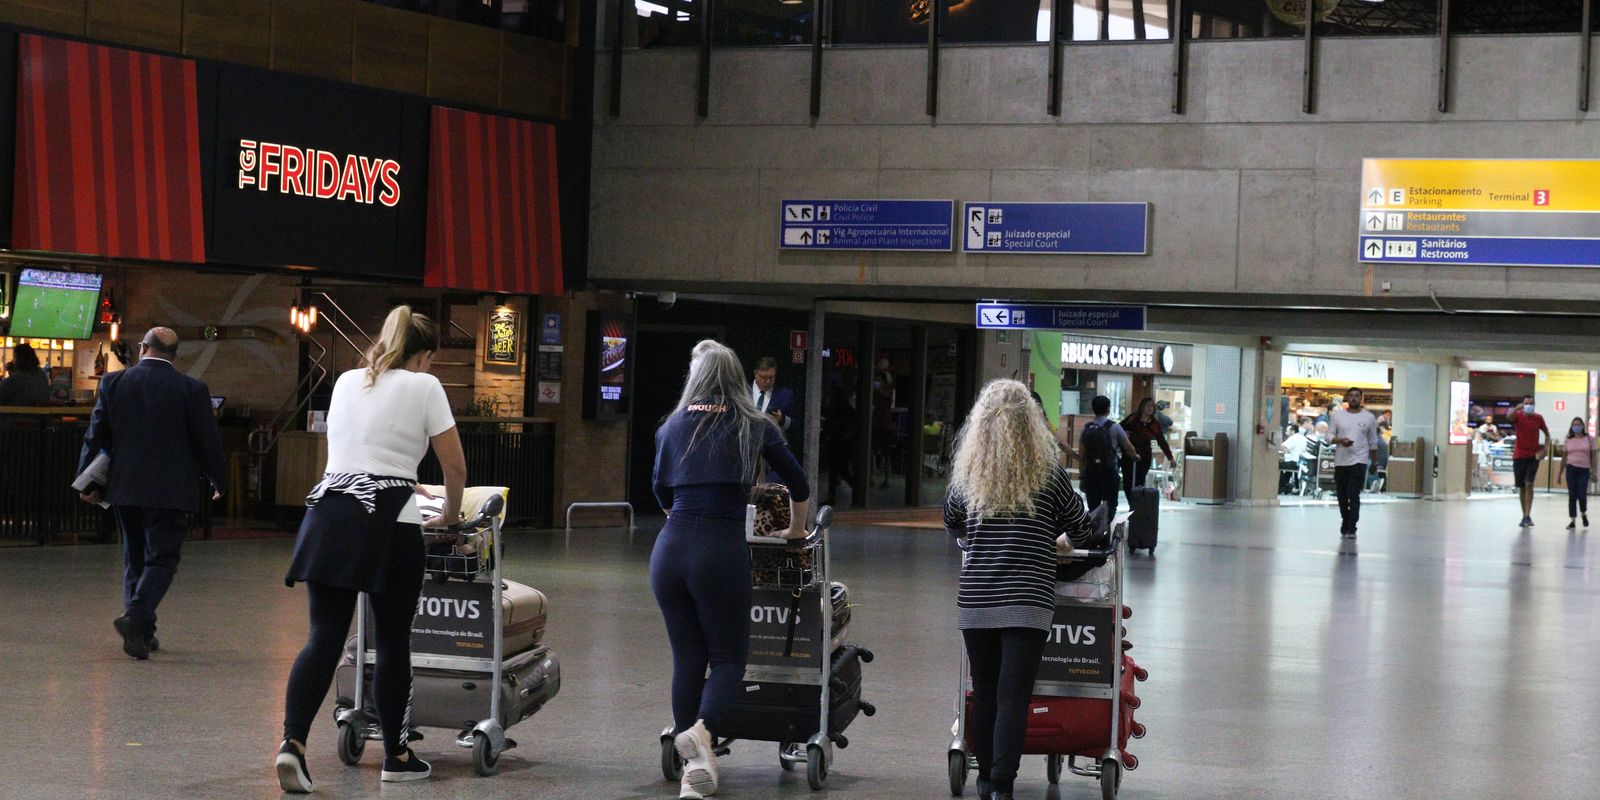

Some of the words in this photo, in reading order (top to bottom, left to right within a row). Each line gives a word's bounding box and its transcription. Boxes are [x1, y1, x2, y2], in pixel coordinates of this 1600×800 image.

[239, 139, 256, 189] TGI
[258, 142, 401, 207] FRIDAYS
[1393, 191, 1401, 202] E
[1409, 187, 1482, 196] Estacionamento
[1409, 197, 1443, 208] Parking
[1489, 192, 1530, 201] Terminal
[1536, 190, 1546, 205] 3
[860, 203, 878, 212] Civil
[1407, 212, 1467, 222] Restaurantes
[898, 227, 949, 236] Internacional
[1407, 222, 1461, 232] Restaurants
[1004, 230, 1036, 239] Juizado
[1037, 230, 1071, 241] especial
[833, 237, 861, 246] Animal
[862, 238, 877, 246] and
[878, 237, 899, 246] Plant
[900, 238, 942, 247] Inspection
[1004, 239, 1034, 249] Special
[1035, 240, 1058, 248] Court
[1421, 239, 1467, 249] Sanitários
[1421, 249, 1469, 259] Restrooms
[1058, 310, 1088, 319] Juizado
[1089, 310, 1119, 321] especial
[1058, 318, 1086, 327] Special
[1086, 318, 1108, 326] Court
[1109, 345, 1154, 369] COFFEE
[1297, 356, 1327, 379] VIENA
[687, 404, 727, 413] ENOUGH
[750, 605, 801, 625] OTV
[1041, 655, 1072, 664] tecnologia
[1081, 656, 1100, 664] Brasil.
